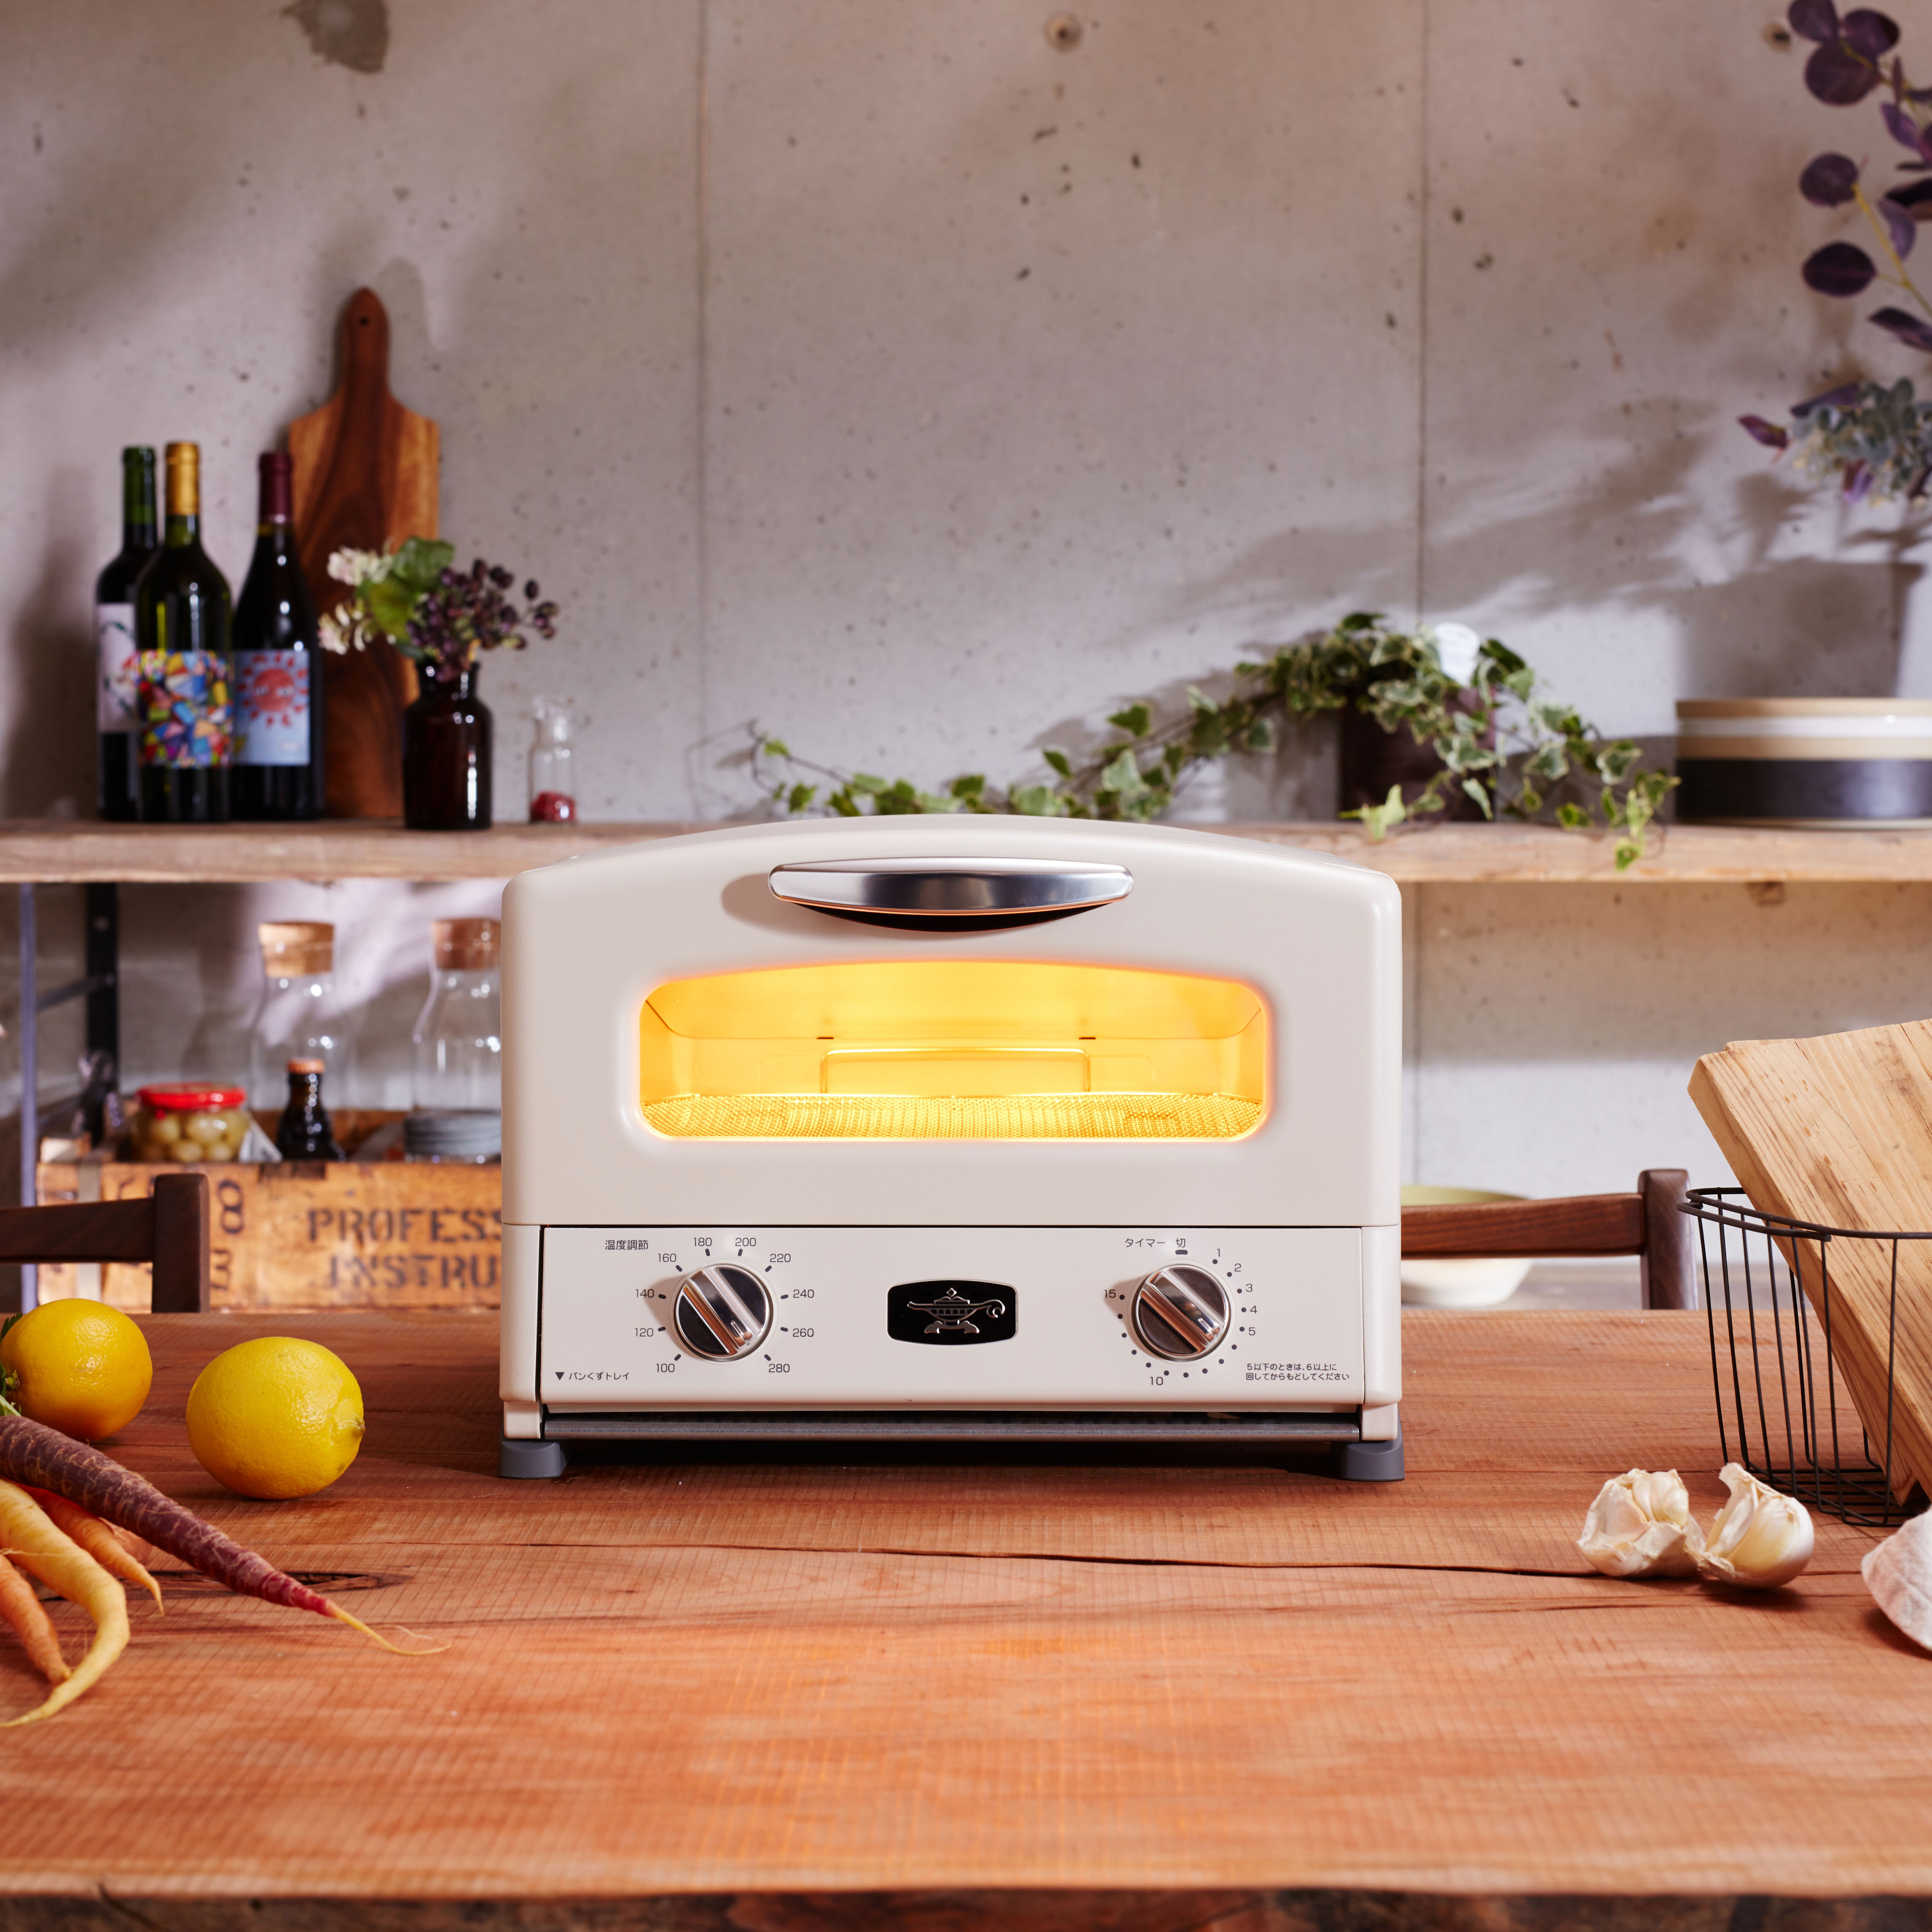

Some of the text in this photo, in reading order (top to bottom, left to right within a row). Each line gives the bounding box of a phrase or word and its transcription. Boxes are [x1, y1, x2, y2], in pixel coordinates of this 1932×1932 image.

[605, 1240, 648, 1250] 温度調節
[693, 1237, 712, 1246] 180
[735, 1237, 756, 1246] 200
[1125, 1238, 1165, 1247] タイマー
[1176, 1238, 1186, 1248] 切
[658, 1253, 676, 1262] 160
[770, 1253, 791, 1262] 220
[1217, 1249, 1221, 1257] 1
[1234, 1263, 1241, 1272] 2
[1246, 1284, 1253, 1292] 3
[636, 1289, 654, 1298] 140
[793, 1289, 814, 1298] 240
[1104, 1290, 1116, 1299] 15
[1250, 1305, 1257, 1314] 4
[635, 1328, 653, 1337] 120
[793, 1328, 814, 1337] 260
[1249, 1327, 1256, 1336] 5
[656, 1363, 675, 1372] 100
[769, 1364, 790, 1373] 280
[569, 1371, 629, 1380] パンくずトレイ
[1150, 1377, 1163, 1385] 10
